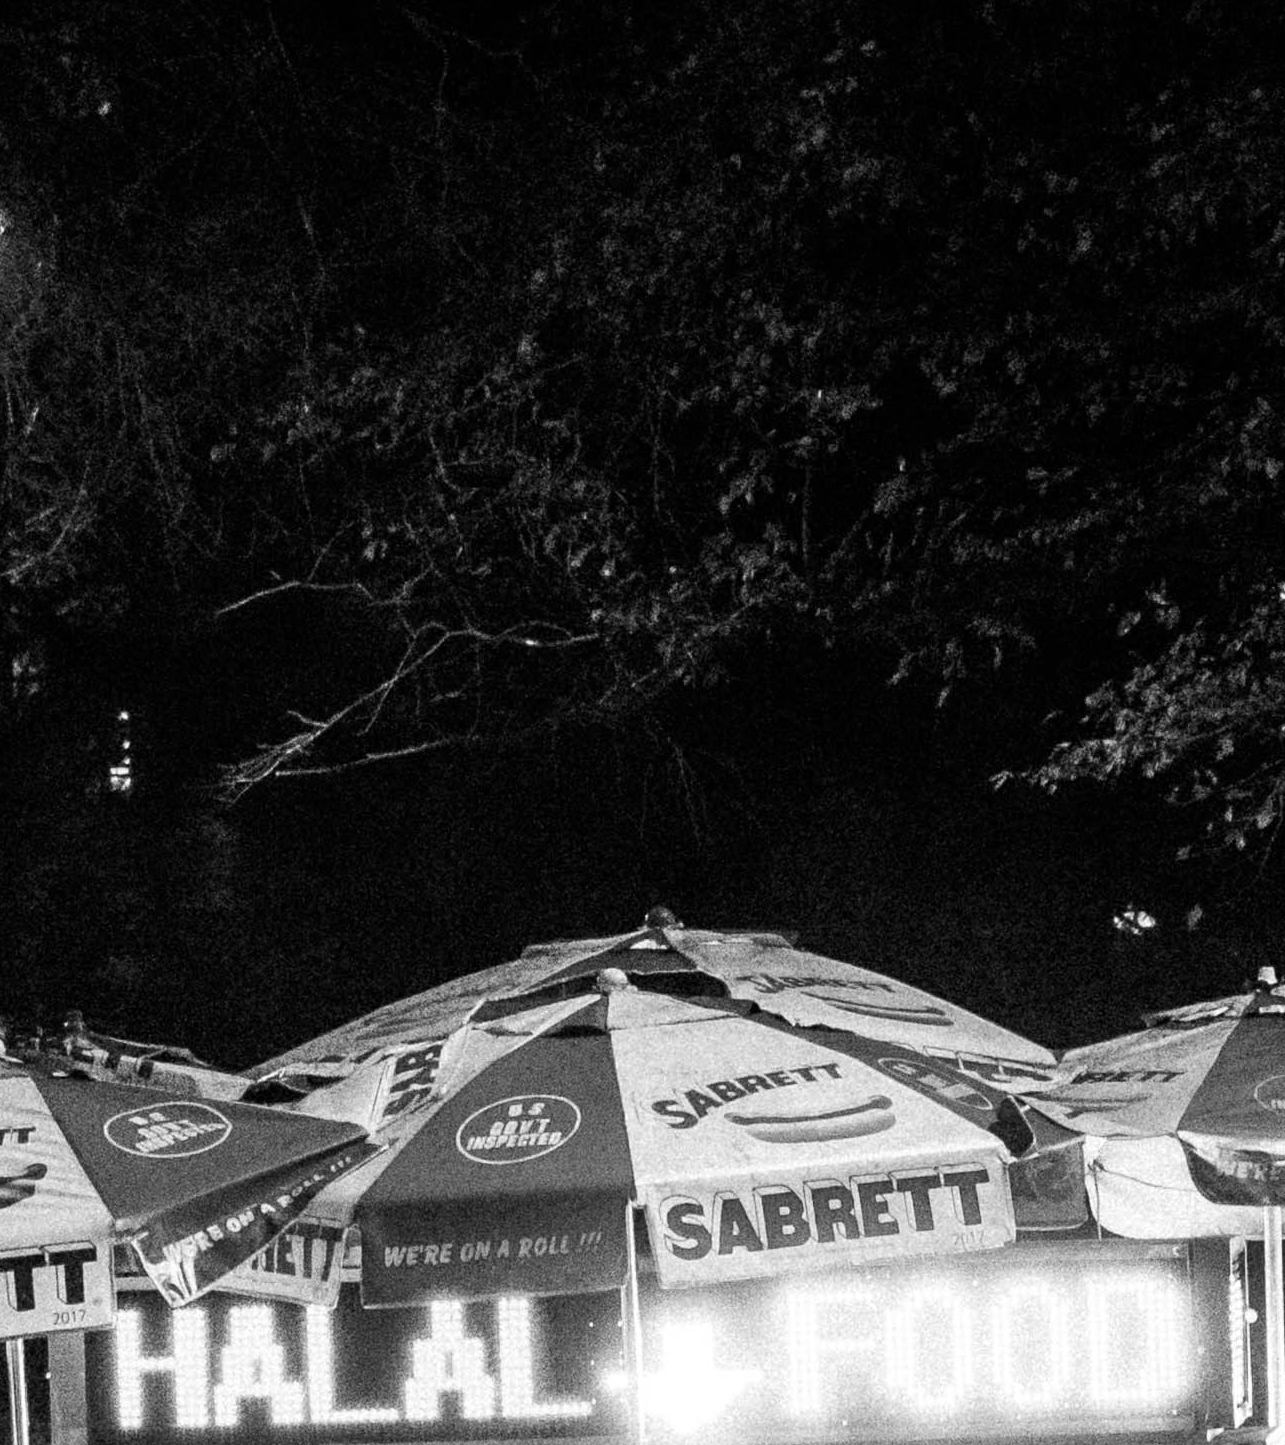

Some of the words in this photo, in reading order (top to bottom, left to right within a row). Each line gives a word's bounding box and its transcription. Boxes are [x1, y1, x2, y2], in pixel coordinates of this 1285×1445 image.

[651, 1061, 844, 1130] SABRETT
[466, 1131, 563, 1151] INSPECTED
[658, 1161, 991, 1261] SABRETT
[383, 1243, 453, 1267] WE'RE
[460, 1240, 491, 1263] ON
[496, 1239, 510, 1259] A
[517, 1234, 569, 1258] ROLL
[52, 1309, 87, 1326] 2017
[116, 1296, 592, 1429] HALAL
[784, 1272, 1186, 1420] FOOD
